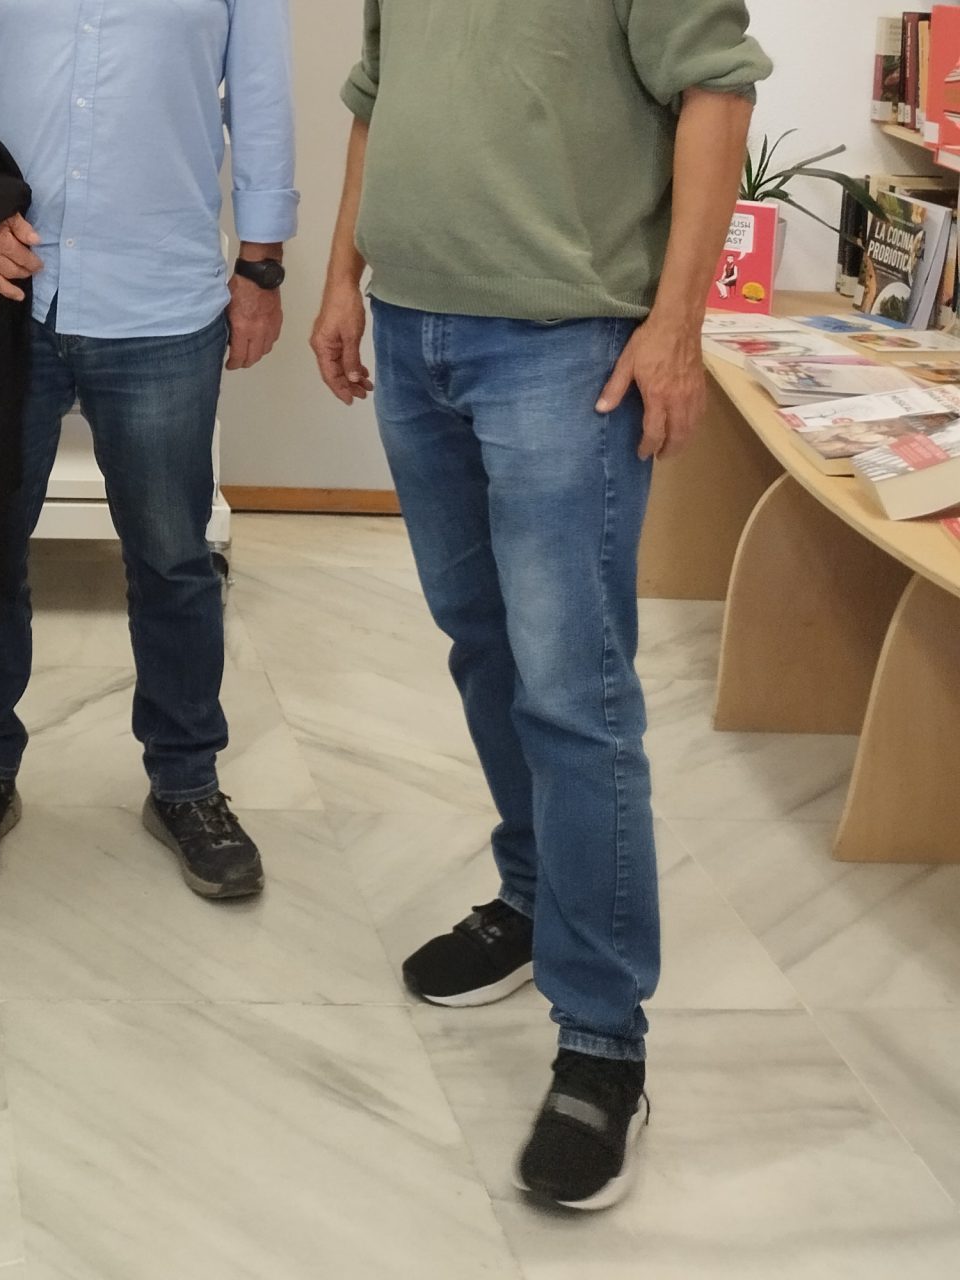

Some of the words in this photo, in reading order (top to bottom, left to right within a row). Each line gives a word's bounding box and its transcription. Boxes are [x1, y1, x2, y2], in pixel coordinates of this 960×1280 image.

[874, 221, 886, 240] LA
[887, 225, 914, 251] COCINA
[867, 241, 912, 272] PROBIÓTICA
